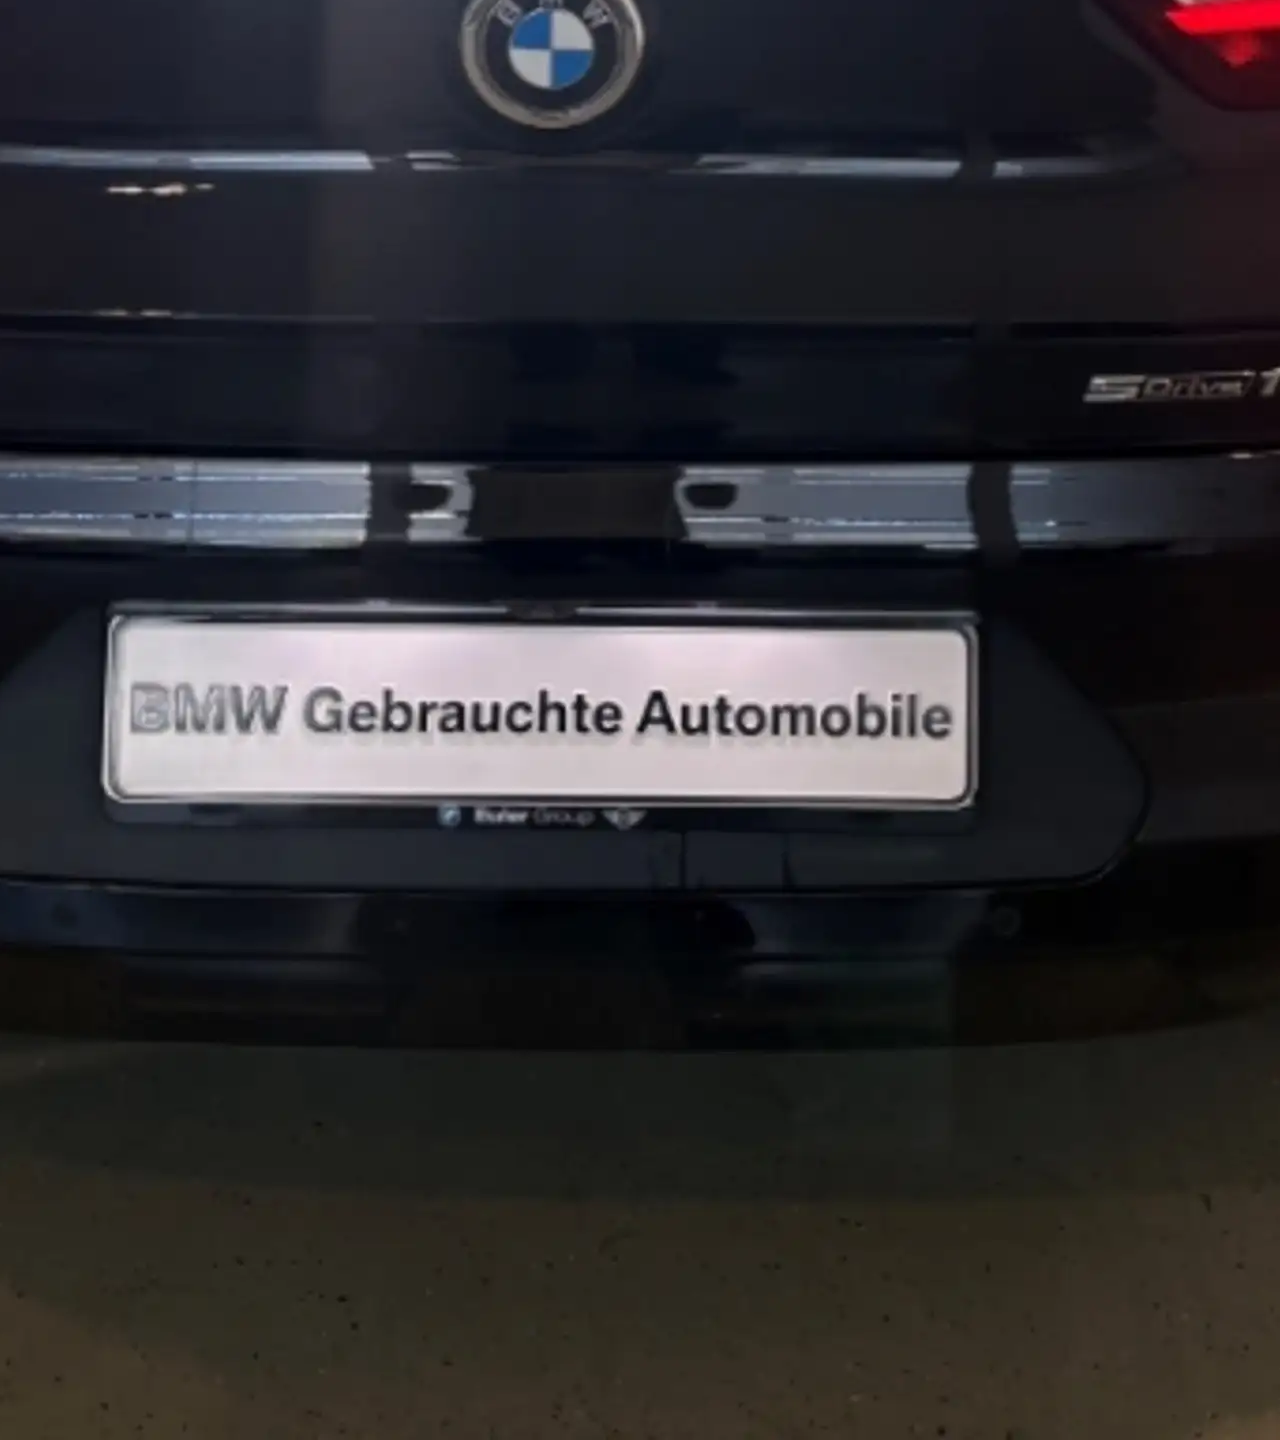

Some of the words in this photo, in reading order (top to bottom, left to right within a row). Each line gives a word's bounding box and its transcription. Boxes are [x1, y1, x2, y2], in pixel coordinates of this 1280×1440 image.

[129, 682, 289, 735] BMW
[303, 685, 624, 736] Gebrauchte
[635, 689, 954, 740] Automobile
